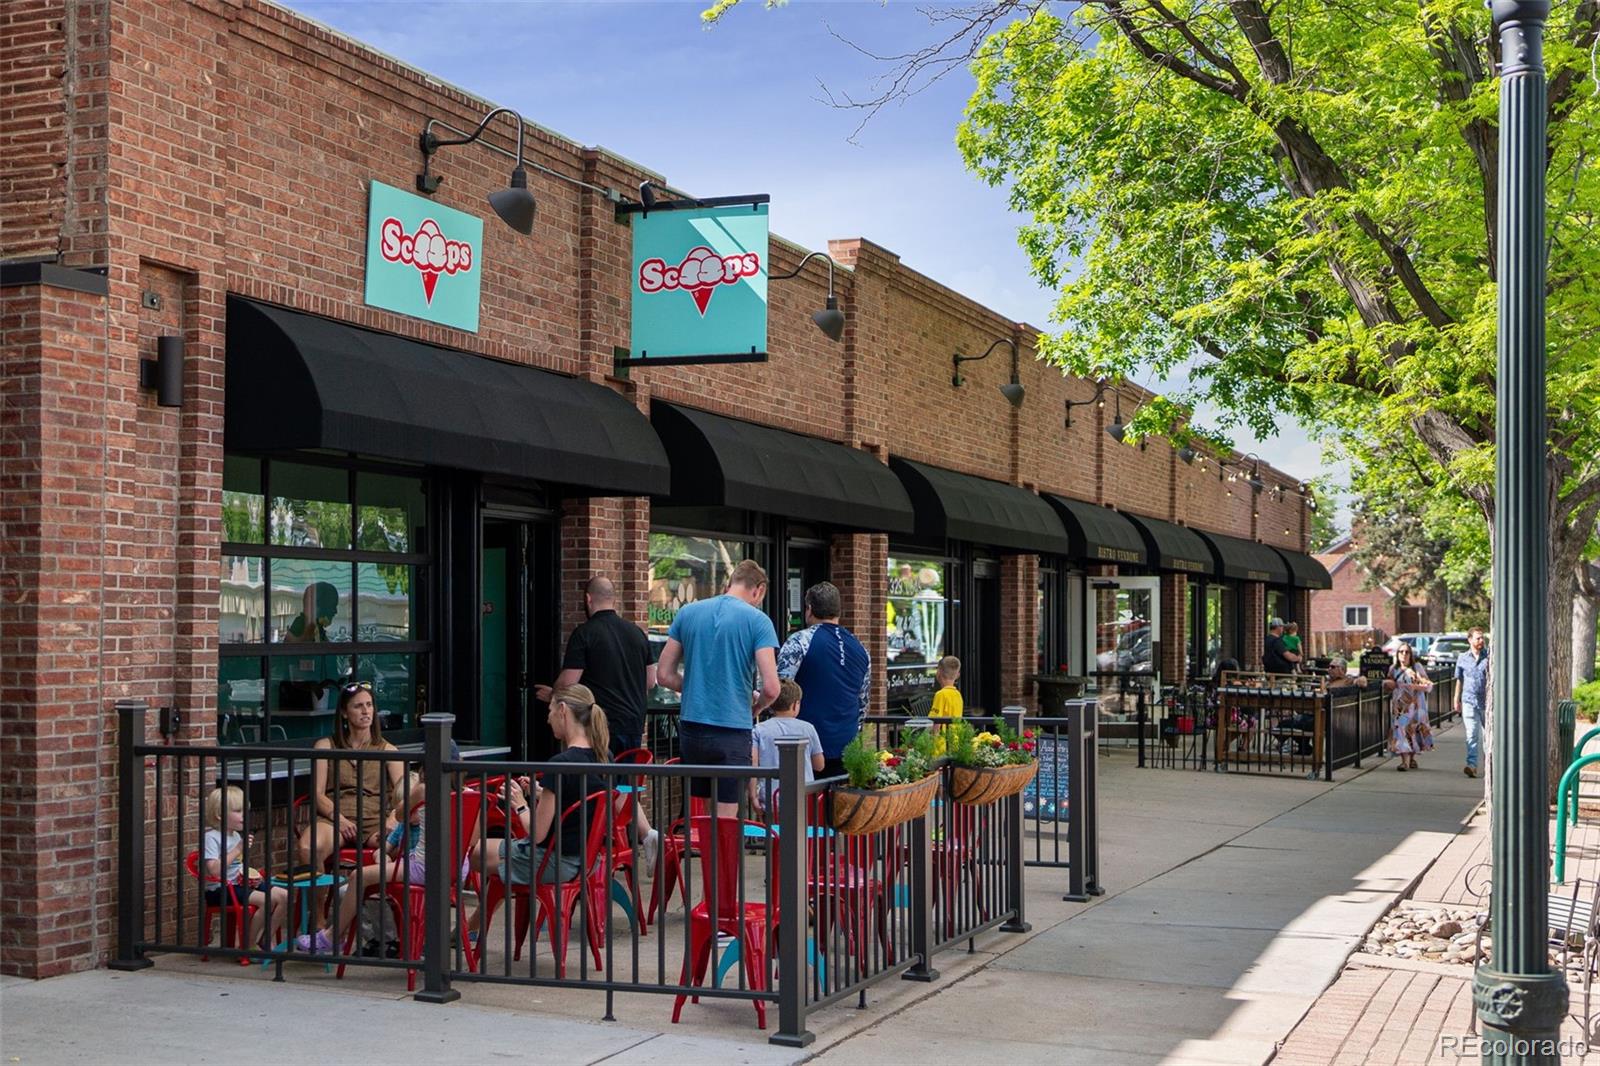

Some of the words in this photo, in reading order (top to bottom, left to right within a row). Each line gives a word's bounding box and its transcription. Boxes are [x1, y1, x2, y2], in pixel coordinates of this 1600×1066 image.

[381, 217, 472, 274] Scoops
[639, 245, 760, 293] Scoops
[1097, 546, 1116, 560] BISTRO
